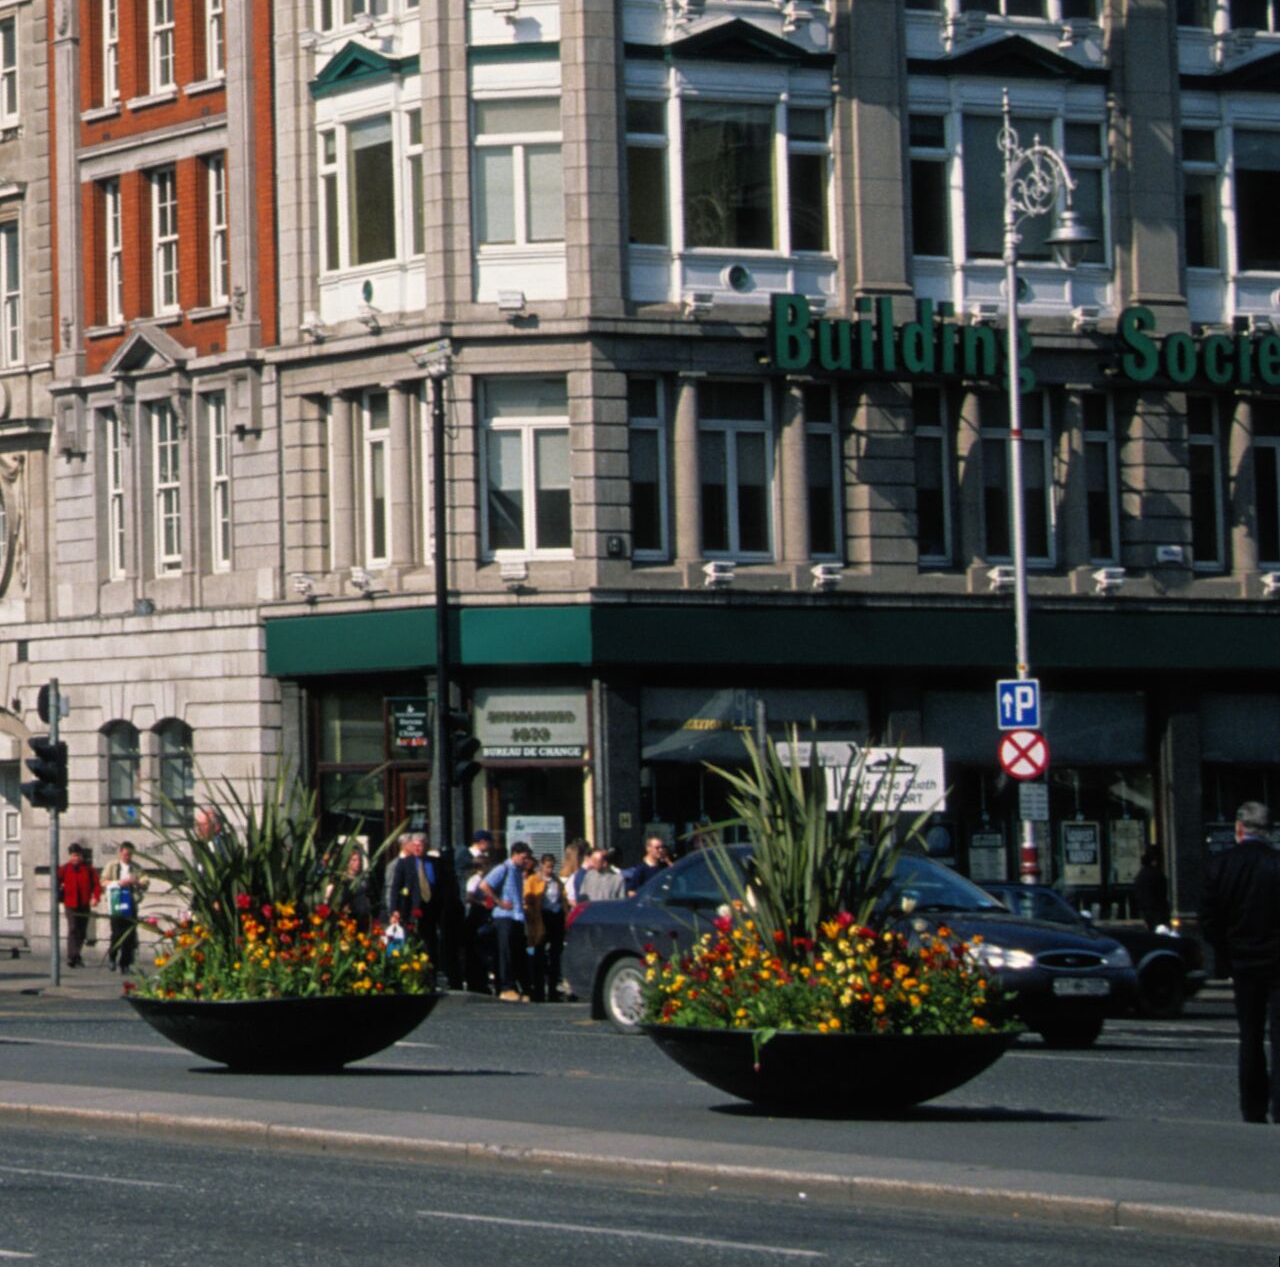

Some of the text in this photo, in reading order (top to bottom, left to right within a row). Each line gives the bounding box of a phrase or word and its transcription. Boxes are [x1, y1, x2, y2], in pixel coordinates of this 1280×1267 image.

[771, 293, 1280, 395] Building Socie
[1014, 685, 1035, 723] P
[482, 746, 582, 758] BUREAU DE CHANGE
